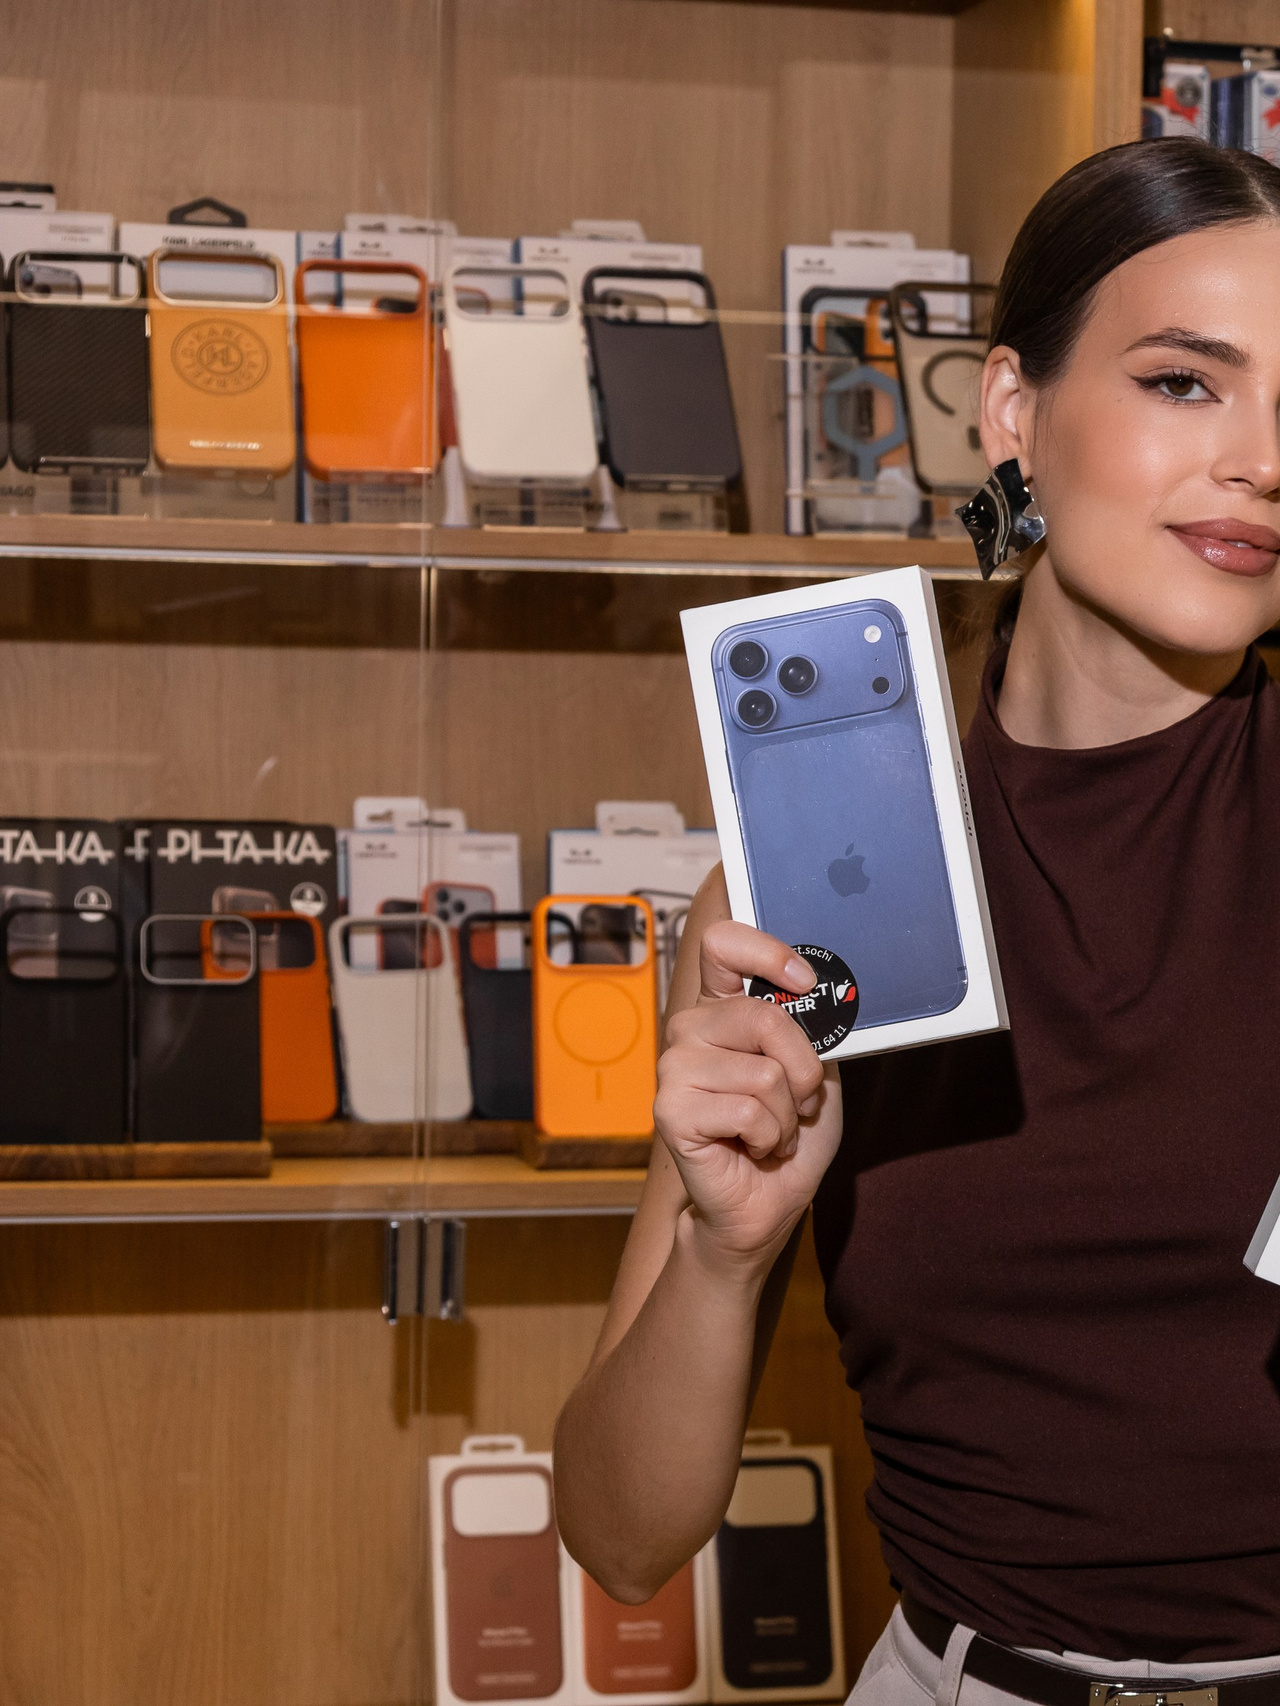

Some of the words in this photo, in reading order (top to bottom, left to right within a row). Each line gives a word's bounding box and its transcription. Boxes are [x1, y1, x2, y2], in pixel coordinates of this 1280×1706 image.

[793, 946, 834, 962] t.sochi
[781, 998, 817, 1014] TER
[811, 1040, 823, 1051] 01
[823, 1033, 836, 1047] 64
[834, 1025, 847, 1037] 11
